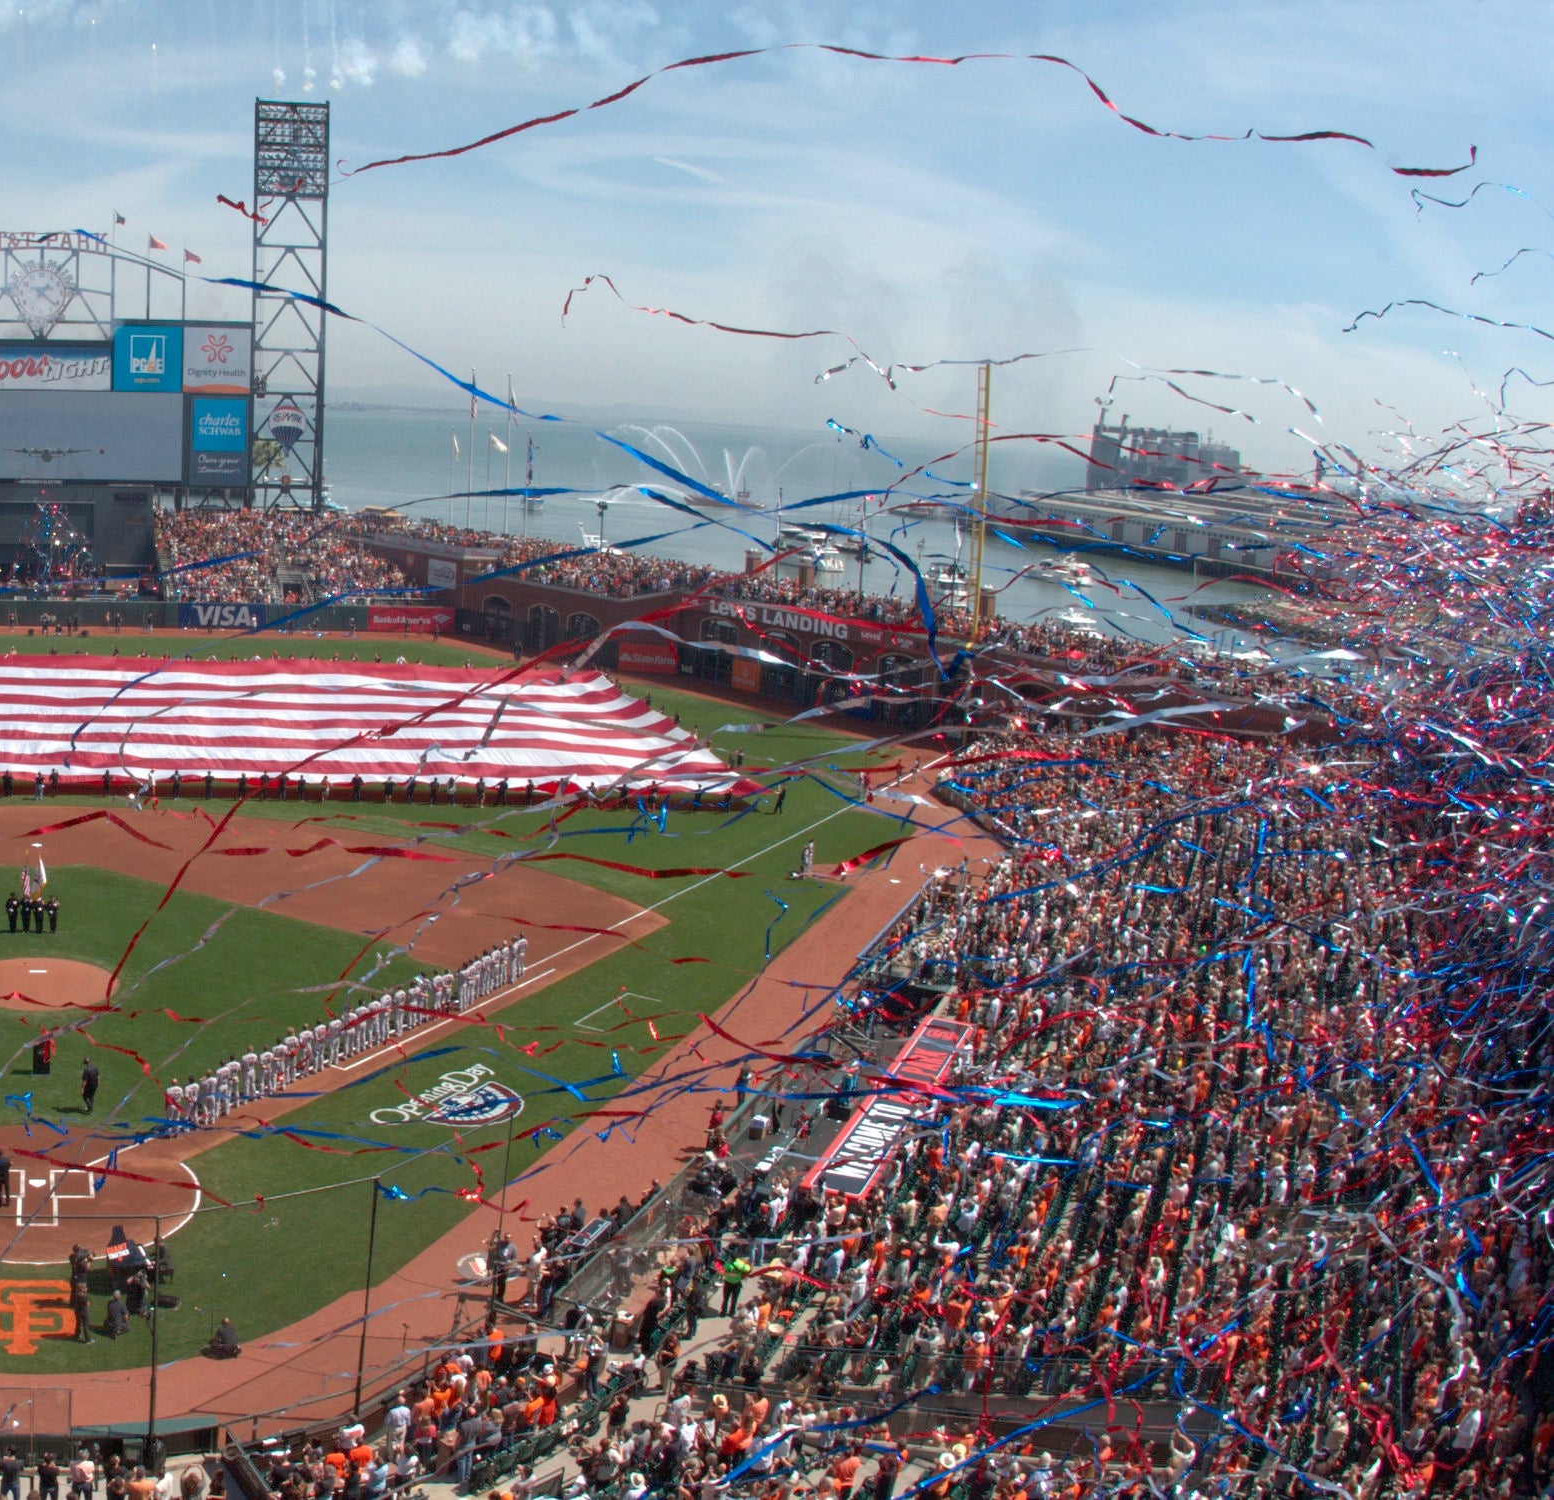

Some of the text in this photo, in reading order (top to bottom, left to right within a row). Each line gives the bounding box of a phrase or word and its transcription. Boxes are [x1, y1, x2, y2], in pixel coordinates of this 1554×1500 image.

[46, 230, 108, 256] PARK
[41, 357, 110, 382] LIGHT
[132, 357, 163, 373] PG&E
[187, 367, 246, 378] Dignity Health
[199, 412, 241, 427] charles
[198, 426, 242, 436] SCHWAB
[193, 605, 252, 626] VISA
[373, 615, 431, 625] Bank of America
[762, 608, 848, 639] LANDING
[633, 653, 676, 666] State Farm
[369, 1063, 495, 1126] Opening Day
[825, 1118, 901, 1179] WELCOME
[869, 1102, 911, 1120] TO
[901, 1047, 950, 1077] PARK
[106, 1242, 128, 1255] GIANT
